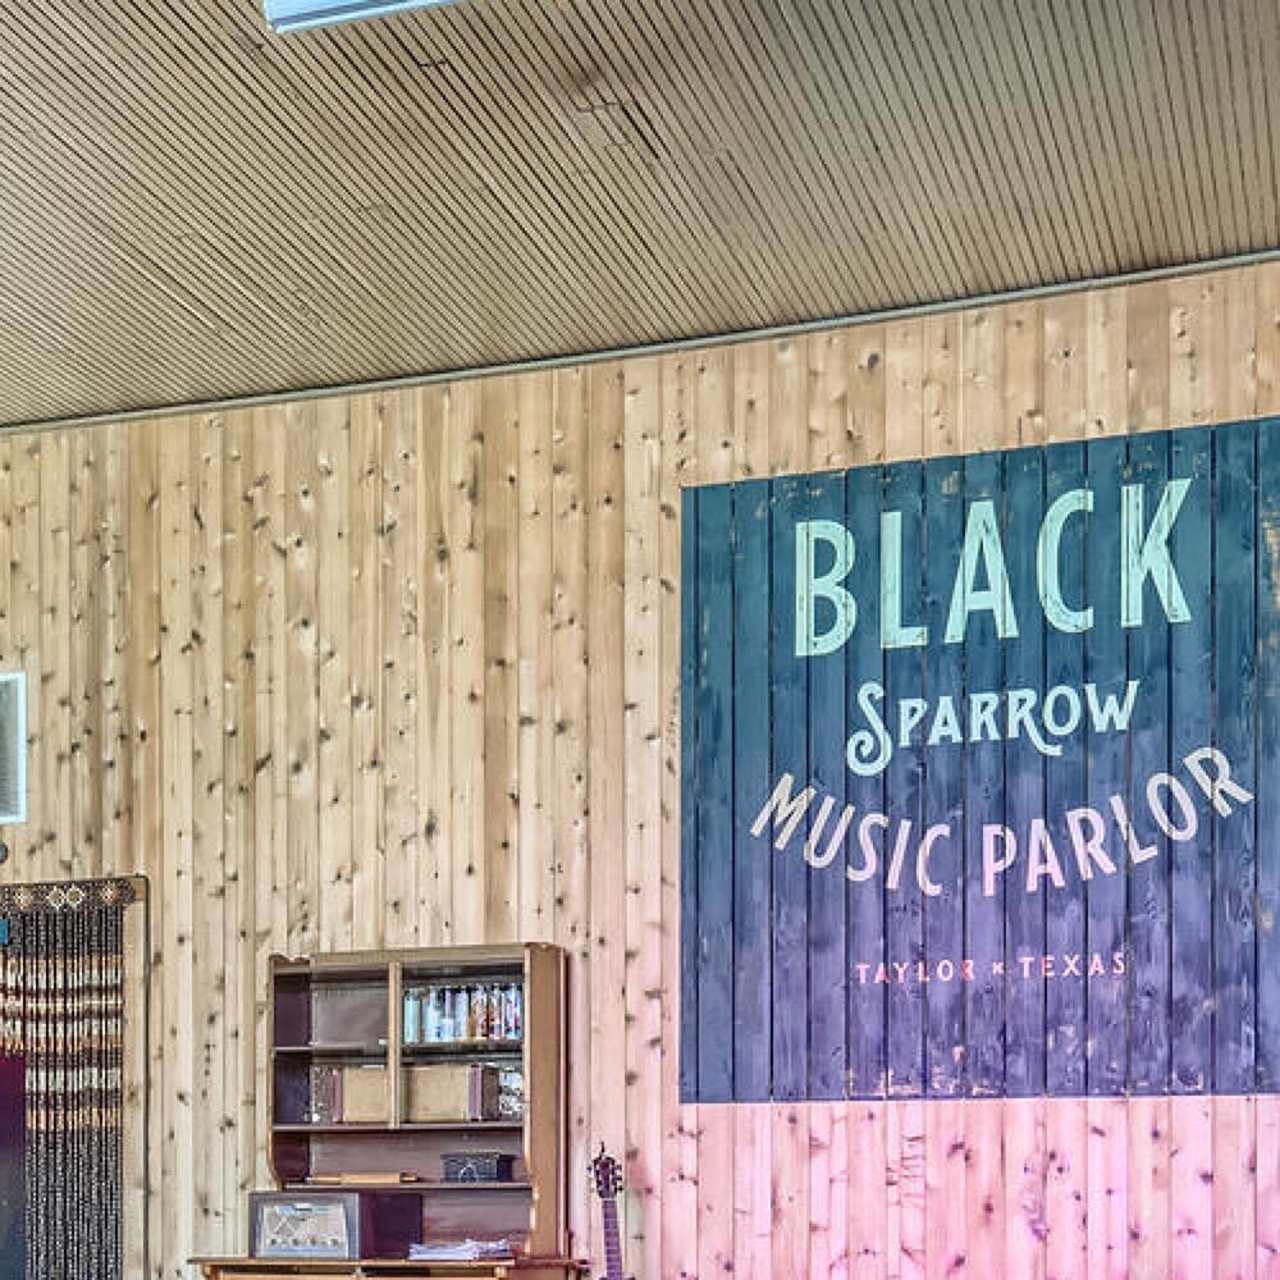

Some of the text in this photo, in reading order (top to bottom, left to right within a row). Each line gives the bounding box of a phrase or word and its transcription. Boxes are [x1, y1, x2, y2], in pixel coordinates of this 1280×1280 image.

[795, 478, 1192, 657] BLACK
[846, 680, 1140, 776] SPARROW
[749, 746, 1255, 897] MUSIC PARLOR
[855, 959, 975, 985] TAYLOR
[1018, 951, 1127, 979] TEXAS
